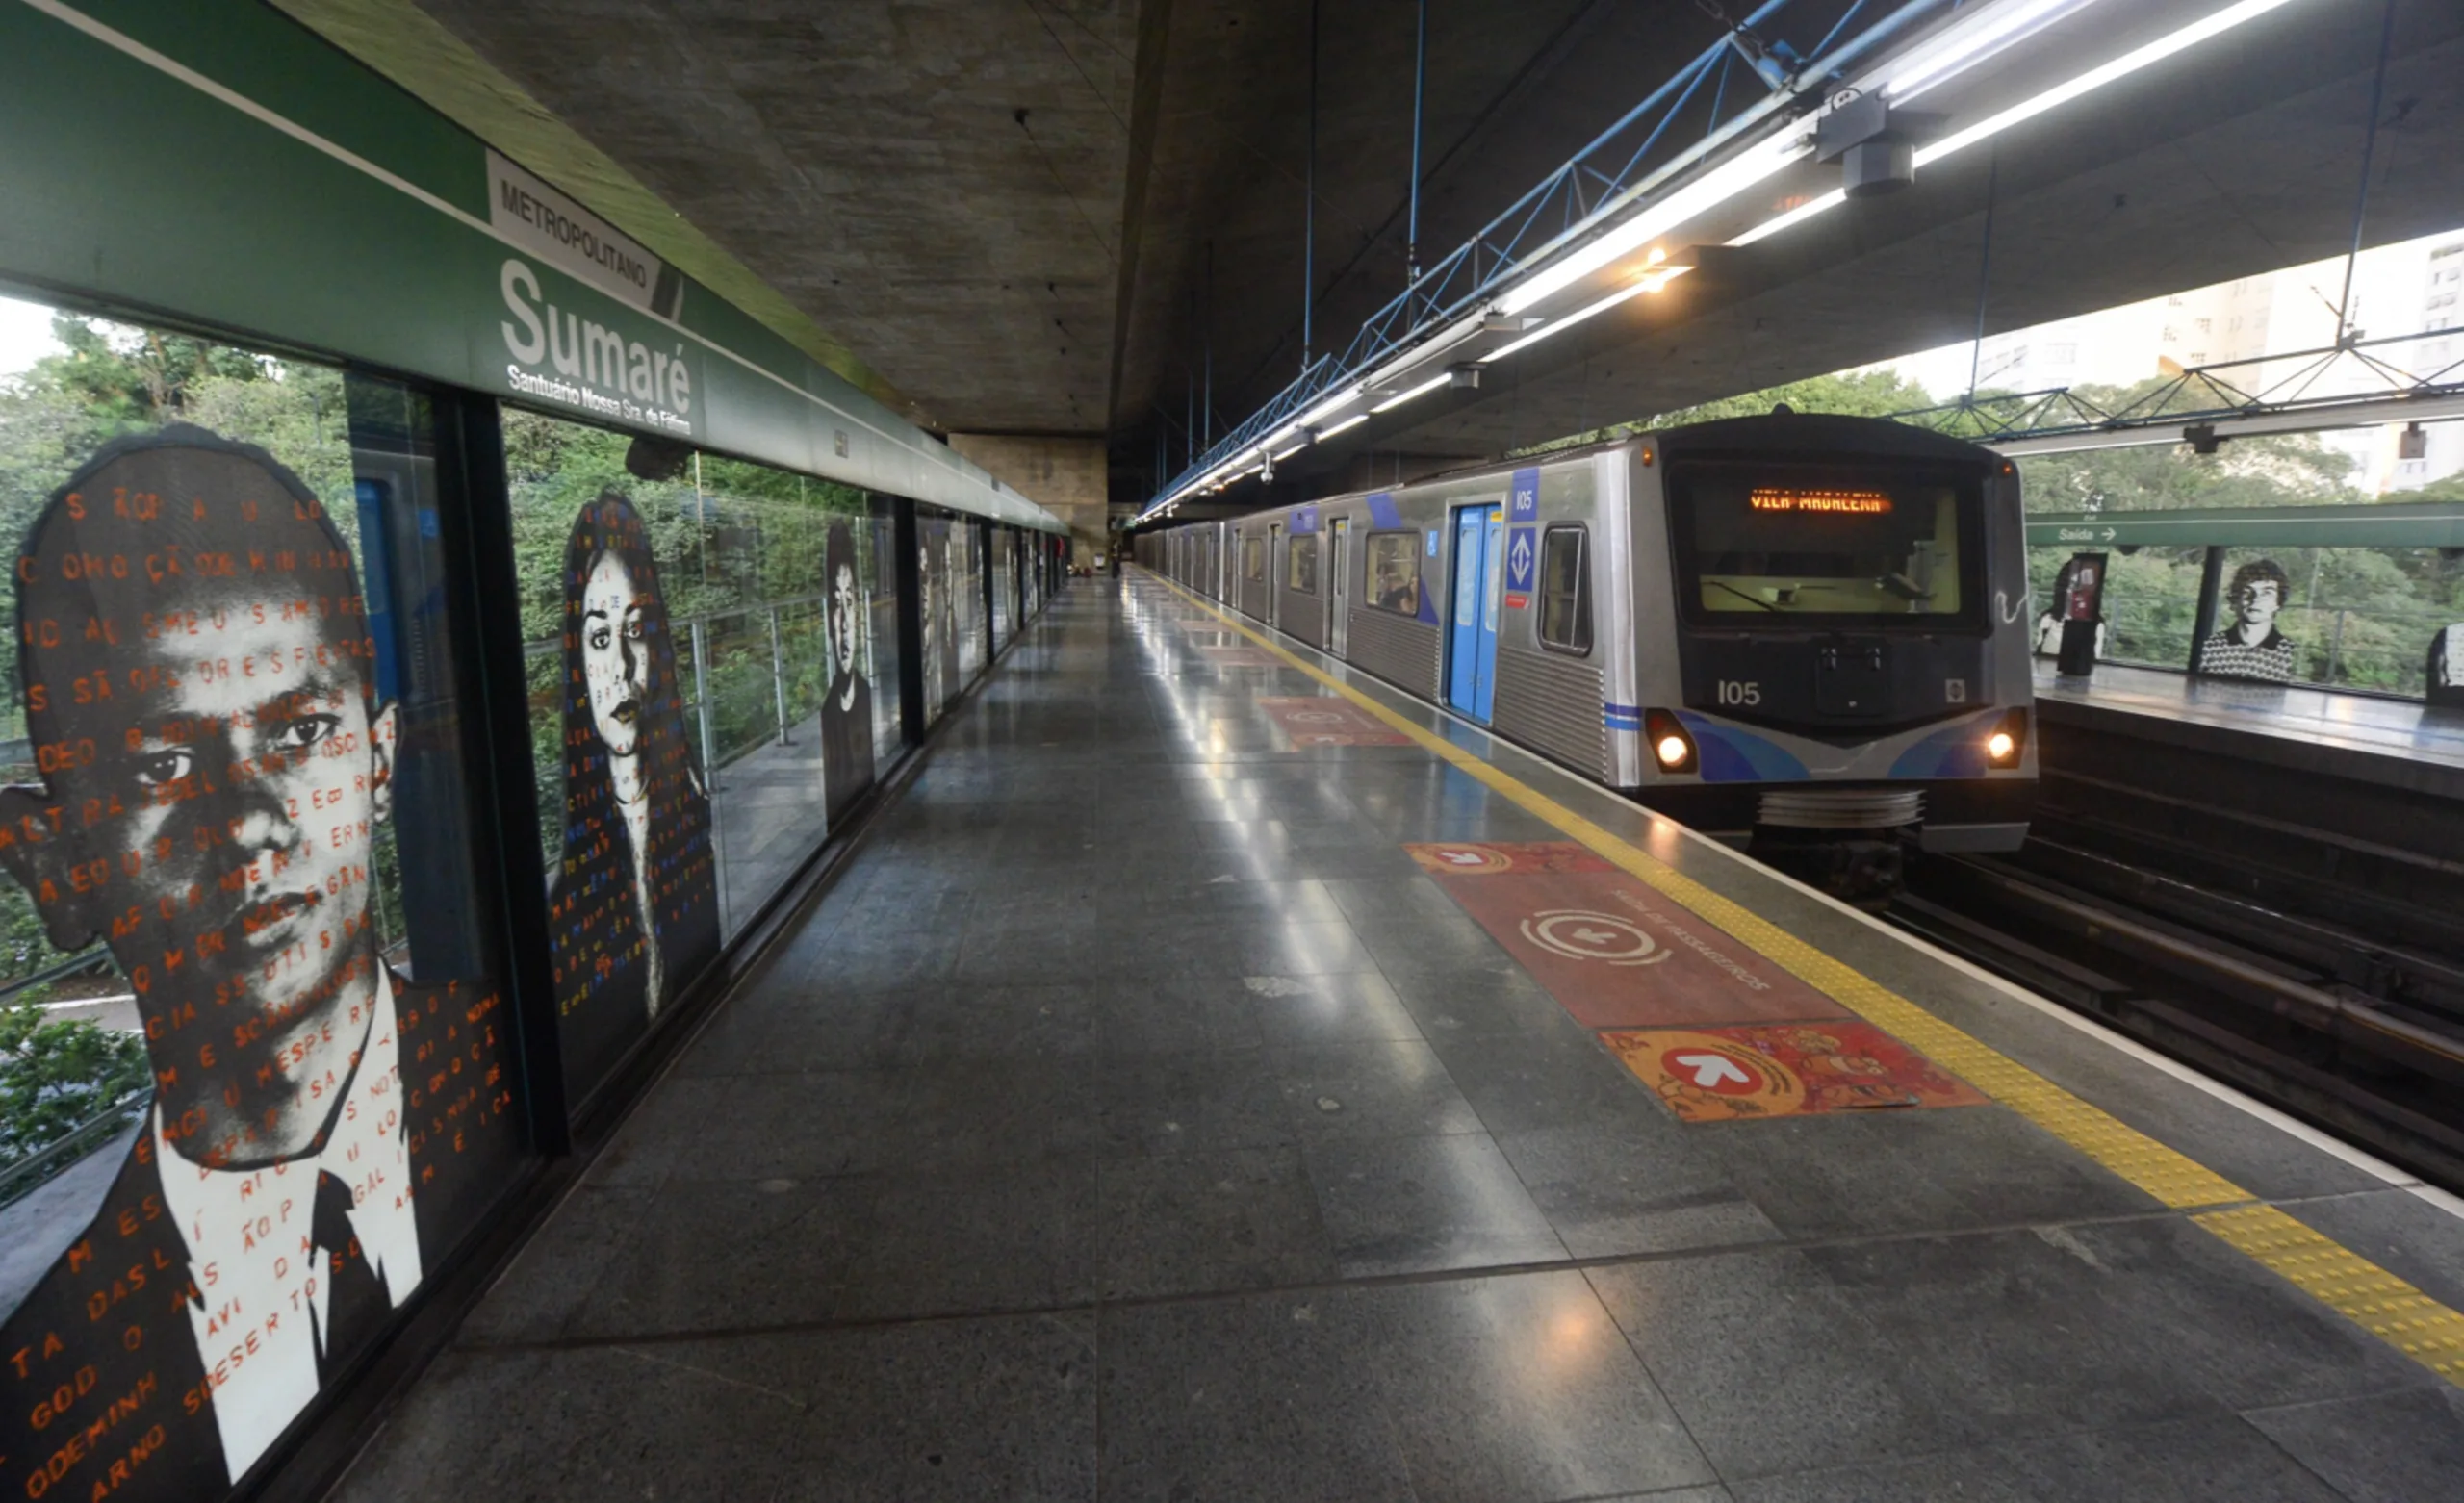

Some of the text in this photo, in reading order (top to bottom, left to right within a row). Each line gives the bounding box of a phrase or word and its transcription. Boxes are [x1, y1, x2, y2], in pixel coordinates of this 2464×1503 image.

[500, 179, 647, 288] METROPOLITANO
[500, 258, 690, 414] Sumaré
[507, 364, 579, 407] Santuário
[581, 386, 621, 418] Nossa
[622, 399, 644, 422] Sra.
[646, 407, 658, 426] de
[1516, 489, 1532, 511] 105
[1751, 489, 1791, 510] VILA
[2059, 528, 2094, 541] Saída
[1718, 679, 1761, 706] 105
